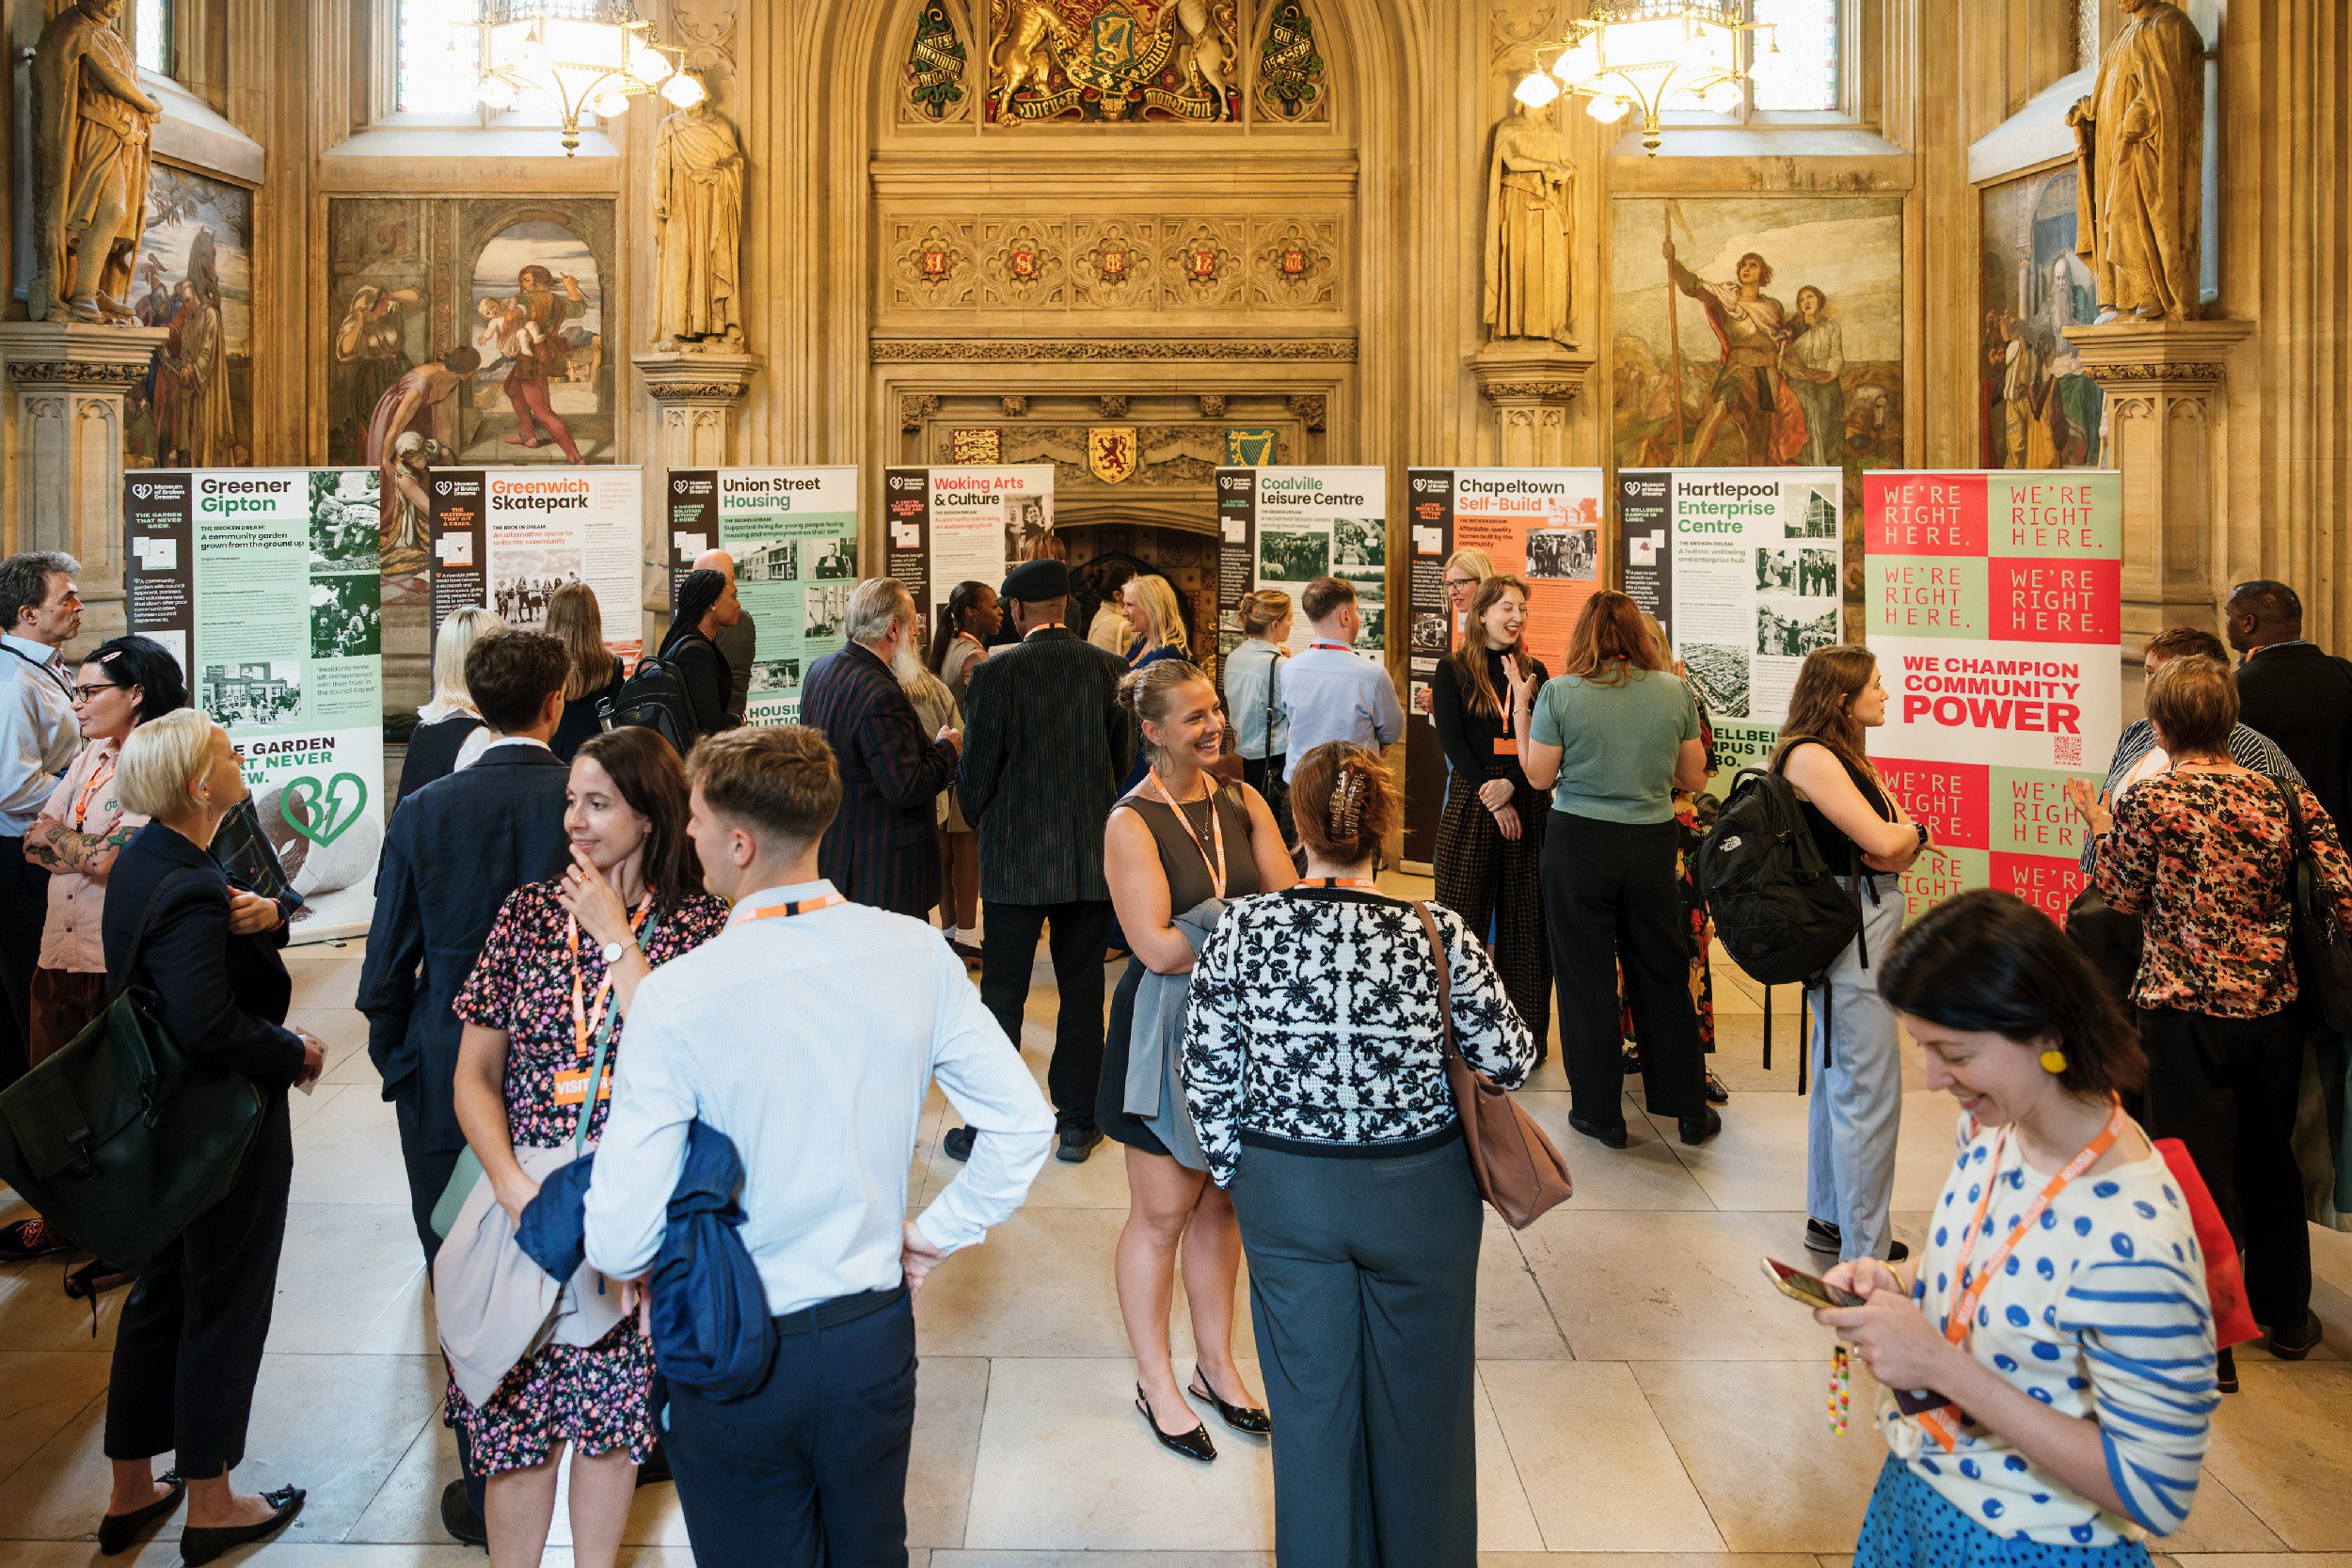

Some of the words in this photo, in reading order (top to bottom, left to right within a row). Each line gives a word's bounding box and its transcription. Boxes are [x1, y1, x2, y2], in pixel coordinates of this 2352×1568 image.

[201, 479, 292, 494] Greener
[492, 478, 590, 494] Greenwich
[723, 477, 770, 492] Union
[773, 478, 820, 490] Street
[934, 476, 990, 493] Woking
[993, 476, 1024, 489] Arts
[1262, 477, 1323, 489] Coalville
[1459, 479, 1565, 497] Chapeltown
[1678, 482, 1779, 500] Hartlepool
[723, 493, 790, 511] Housing
[934, 494, 946, 506] &
[948, 493, 1000, 505] Culture
[1262, 491, 1311, 504] Leisure
[1314, 493, 1364, 505] Centre
[1459, 497, 1542, 511] Self-Build
[1884, 485, 1961, 504] WE'RE
[2010, 486, 2091, 504] WE'RE
[201, 496, 277, 516] Gipton
[492, 495, 589, 514] Skatepark
[1678, 499, 1775, 519] Enterprise
[1885, 506, 1961, 524] RIGHT
[2012, 507, 2093, 525] RIGHT
[1678, 519, 1742, 532] Centre
[1885, 526, 1970, 546] HERE.
[2012, 528, 2103, 548] HERE.
[1884, 566, 1961, 585] WE'RE
[2010, 569, 2093, 590] WE'RE
[1885, 586, 1962, 606] RIGHT
[2012, 590, 2094, 610] RIGHT
[1885, 607, 1970, 628] HERE.
[2012, 610, 2104, 633] HERE.
[1903, 656, 1939, 672] WE
[1945, 657, 2079, 678] CHAMPION
[1904, 674, 2081, 700] COMMUNITY
[750, 705, 800, 718] HOUSI
[1903, 694, 2081, 735] POWER
[1714, 728, 1775, 742] ELLBEI
[253, 737, 335, 754] GARDEN
[265, 752, 332, 768] NEVER
[1884, 771, 1962, 794] WE'RE
[2014, 801, 2078, 825] RIGH
[2013, 823, 2088, 846] HER
[1902, 876, 1963, 897] IGHT
[557, 1076, 608, 1095] VISITR
[2060, 1148, 2098, 1180] VISITOR
[1984, 1242, 2010, 1276] VISITOR
[1956, 1290, 1976, 1325] VISITOR
